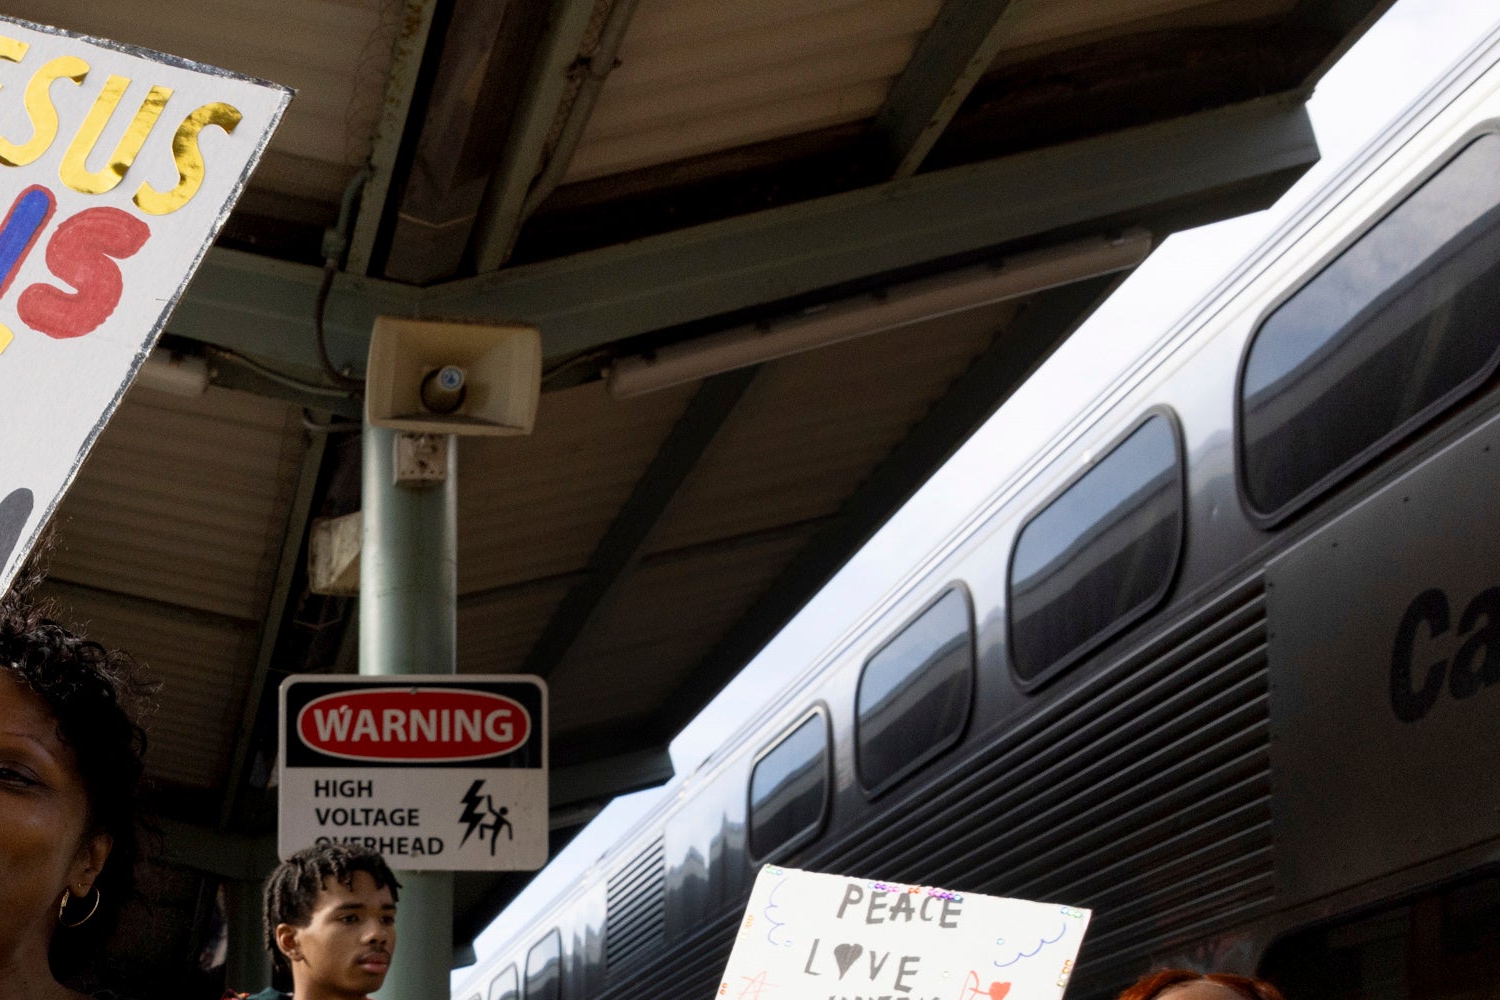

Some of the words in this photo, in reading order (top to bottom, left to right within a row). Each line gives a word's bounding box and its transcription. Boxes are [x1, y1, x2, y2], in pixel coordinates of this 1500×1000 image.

[313, 708, 514, 743] WARNING
[314, 779, 373, 798] HIGH
[315, 808, 420, 827] VOLTAGE
[836, 883, 964, 929] PEACE
